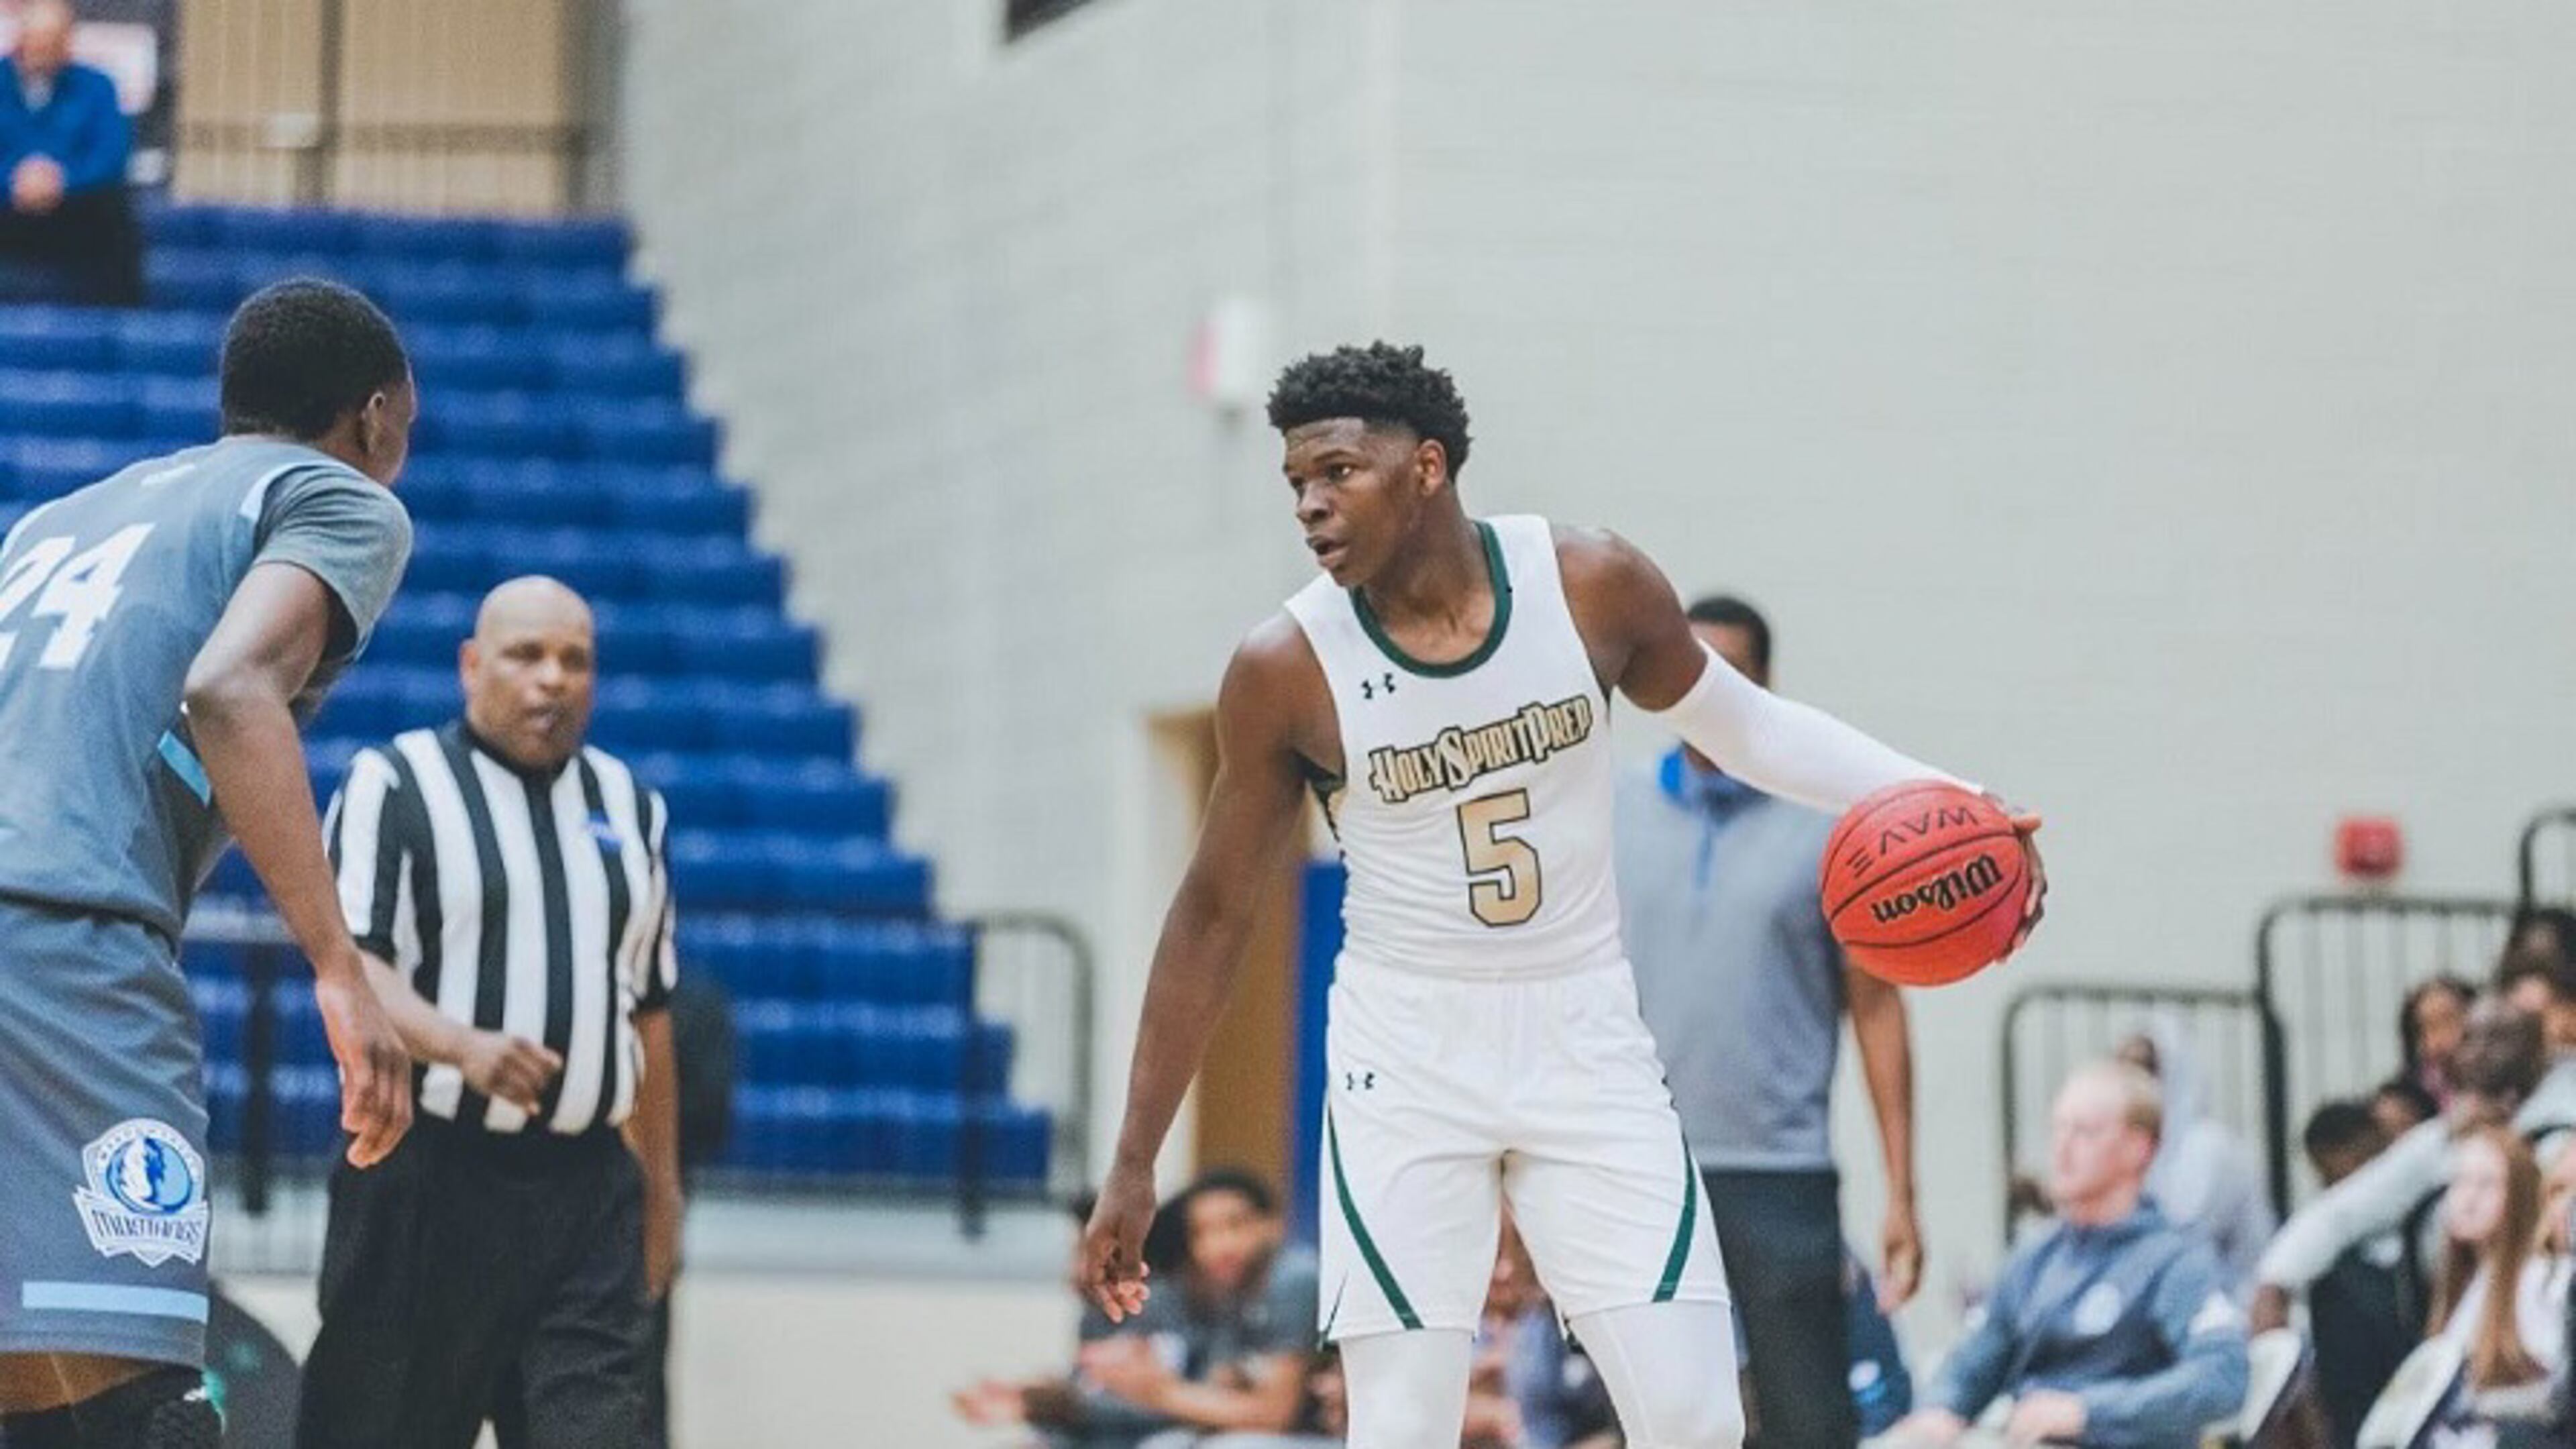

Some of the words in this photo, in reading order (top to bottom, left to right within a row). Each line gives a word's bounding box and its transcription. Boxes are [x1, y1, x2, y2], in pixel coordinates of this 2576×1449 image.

[1456, 788, 1542, 928] 5
[1846, 806, 1978, 879] WAVE
[1871, 853, 2002, 923] Wilson
